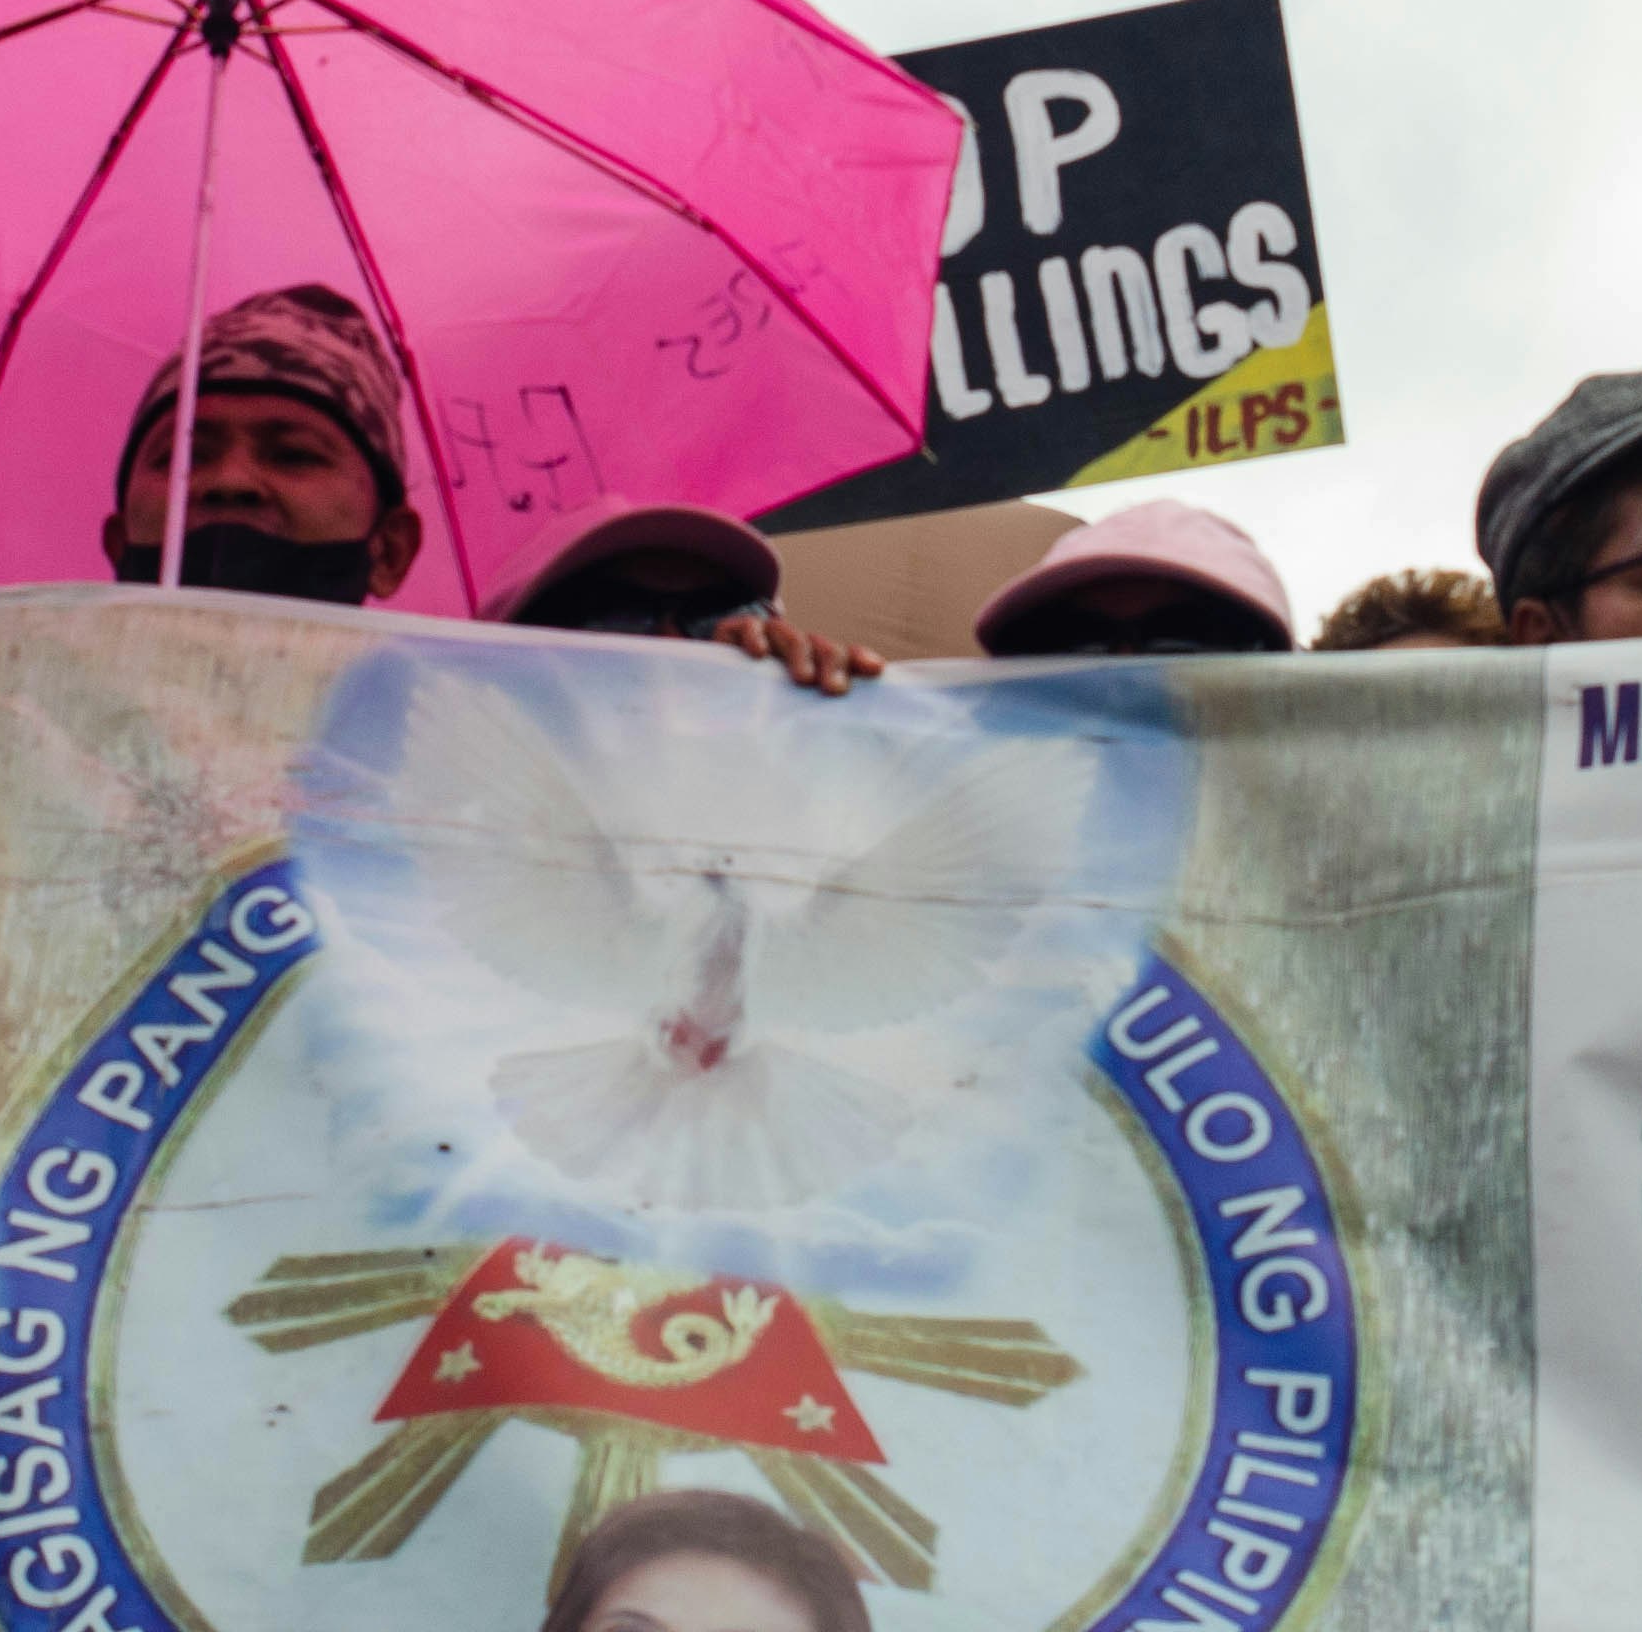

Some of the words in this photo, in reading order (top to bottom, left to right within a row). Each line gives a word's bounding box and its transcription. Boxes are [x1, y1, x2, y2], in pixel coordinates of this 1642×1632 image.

[77, 884, 314, 1133] PANG
[1105, 985, 1273, 1164] ULO
[1218, 1184, 1331, 1335] NG
